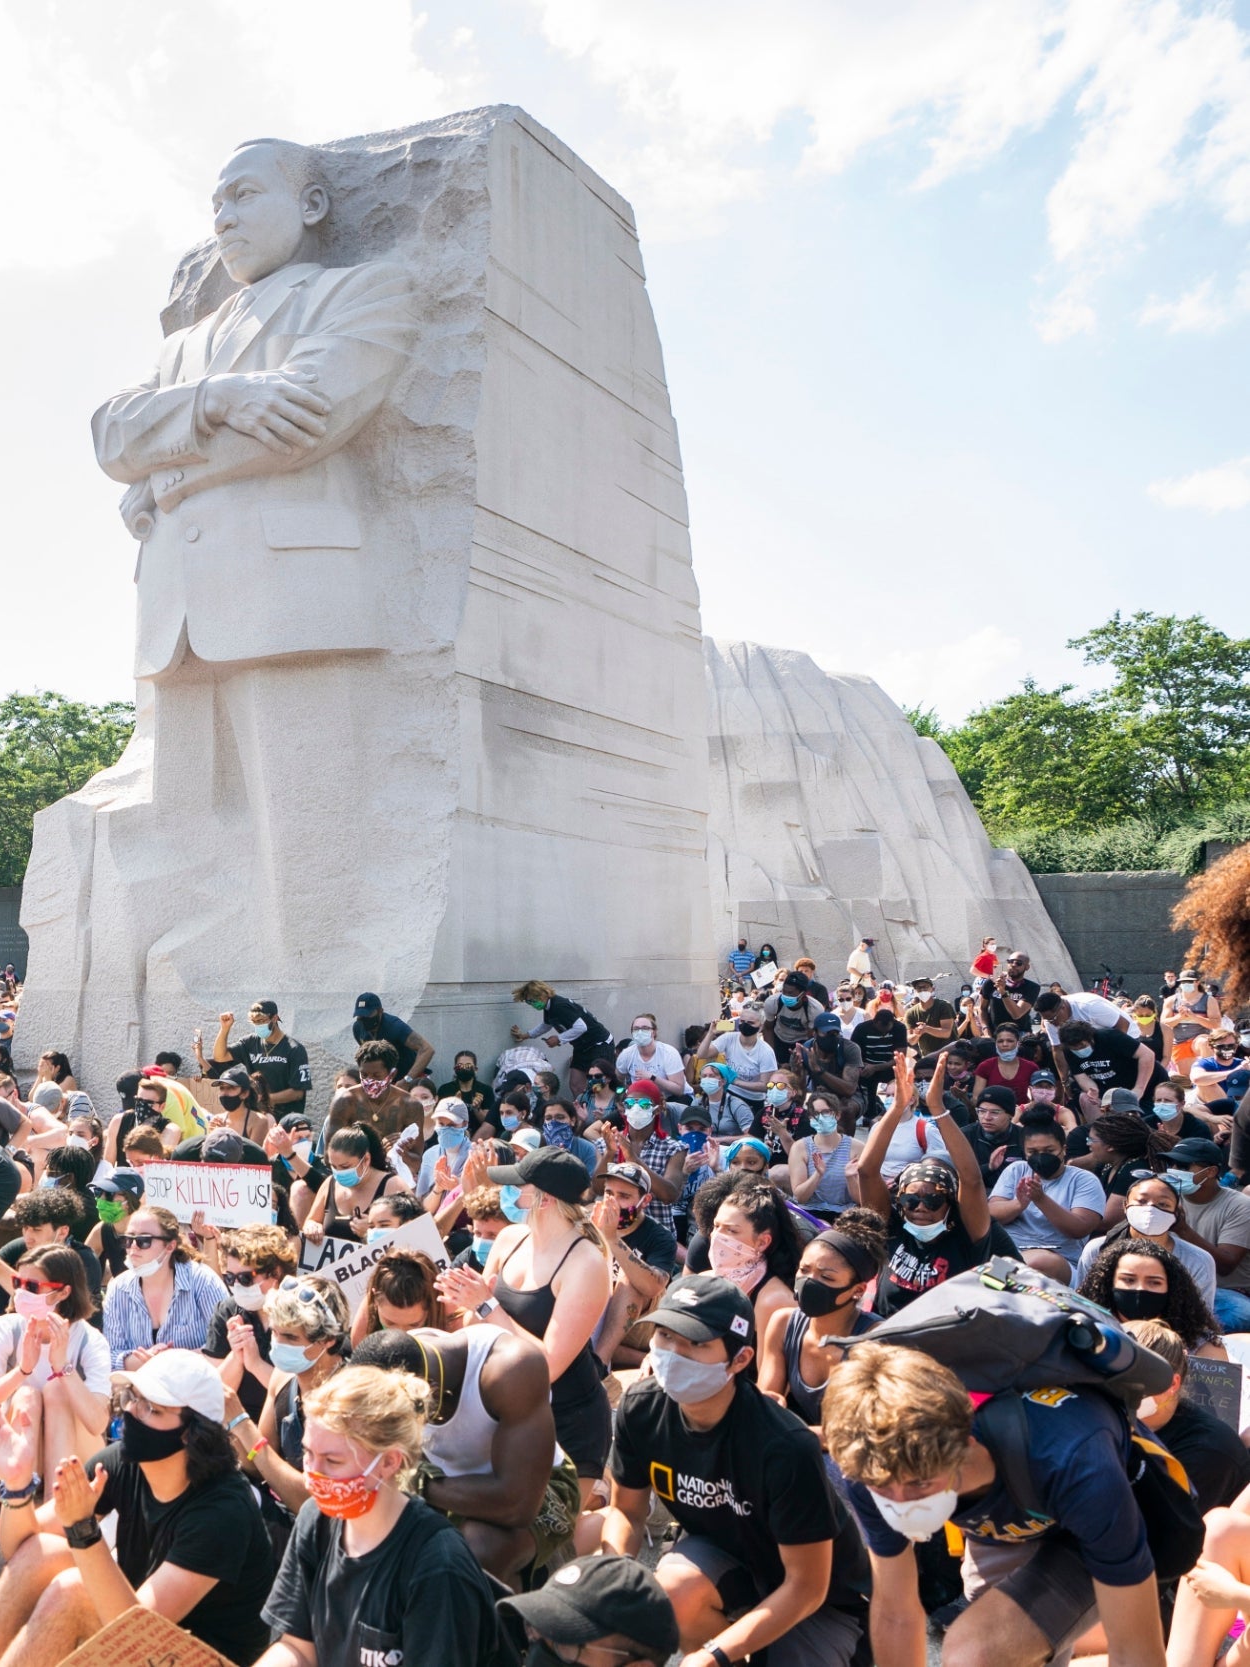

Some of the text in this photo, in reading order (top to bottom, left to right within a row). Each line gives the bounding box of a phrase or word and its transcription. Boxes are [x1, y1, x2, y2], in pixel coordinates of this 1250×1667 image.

[147, 1175, 270, 1209] STOP KILLING US!
